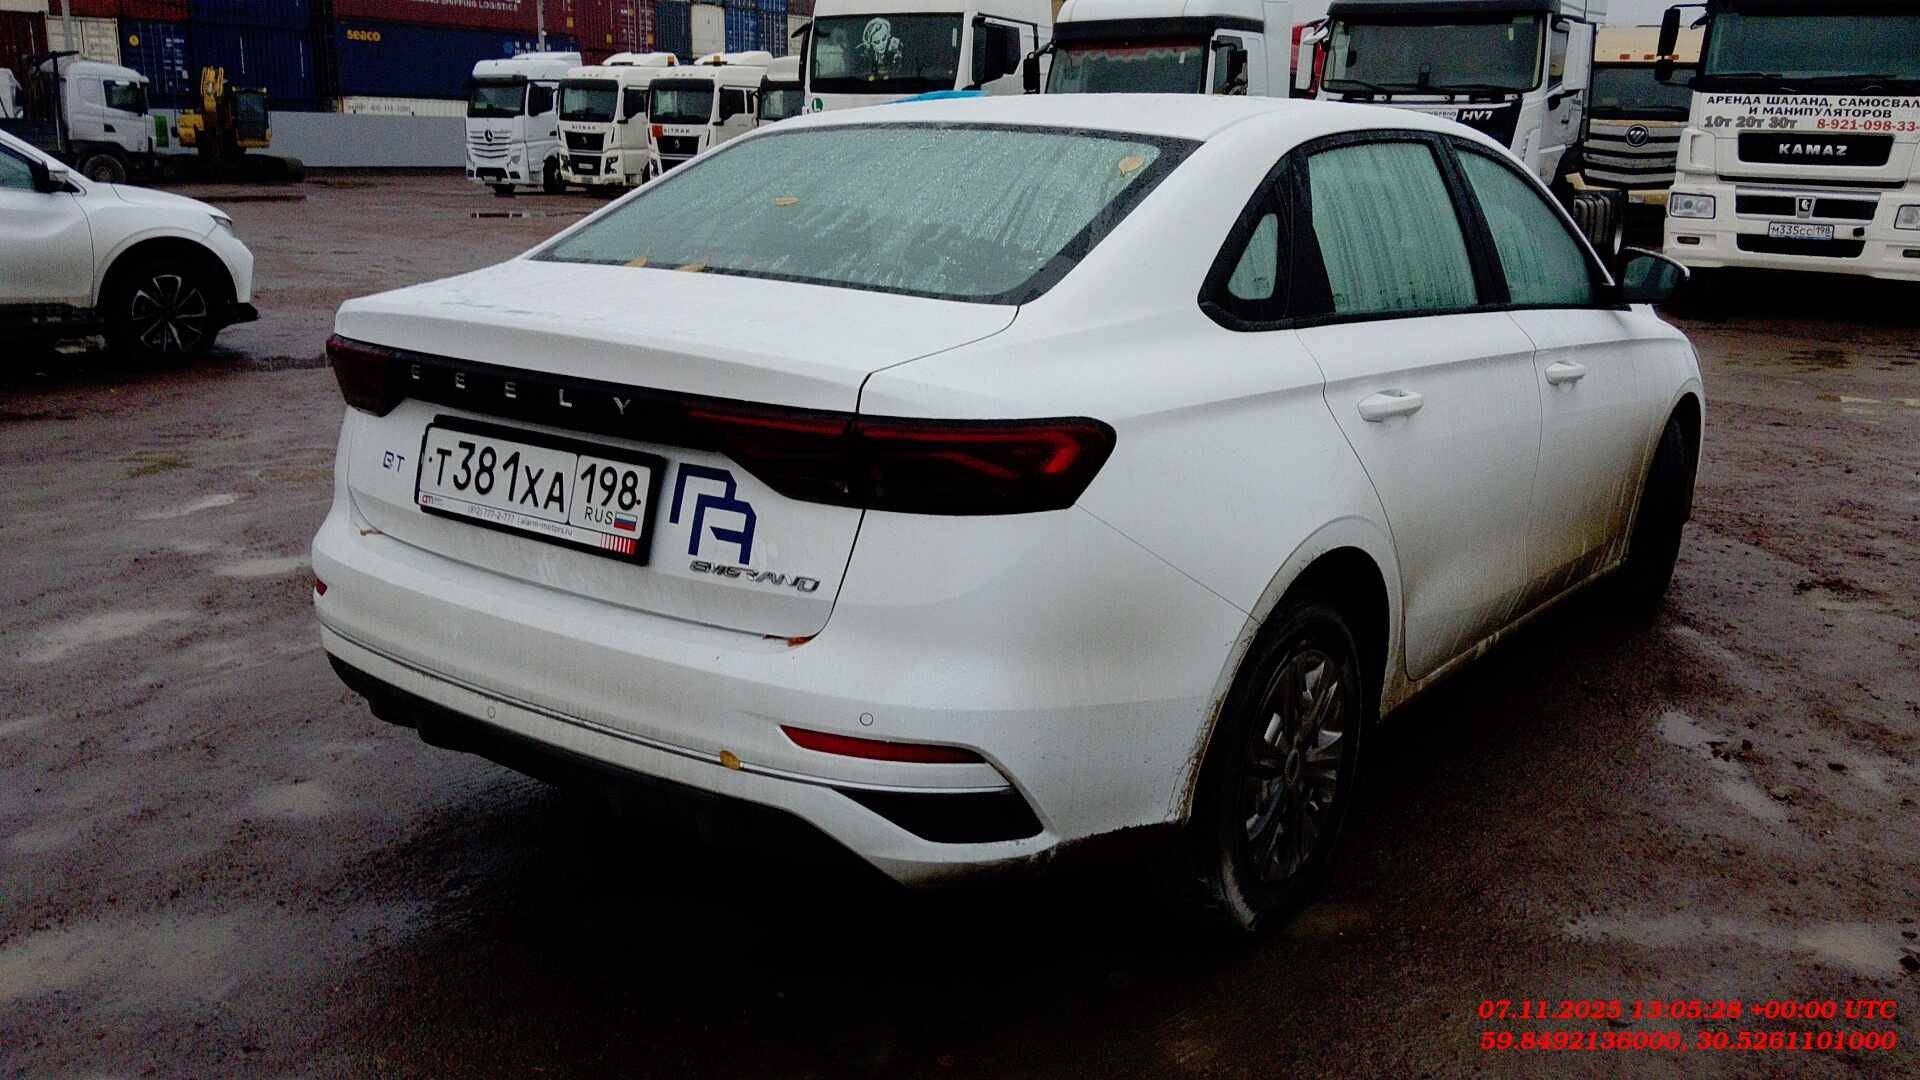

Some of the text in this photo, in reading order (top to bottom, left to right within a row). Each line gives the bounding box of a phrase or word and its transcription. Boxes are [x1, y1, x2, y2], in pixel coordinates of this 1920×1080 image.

[347, 29, 381, 42] seaco
[1706, 95, 1761, 105] АРЕНДА
[1766, 97, 1833, 108] ШАЛАНД,
[1461, 109, 1494, 121] HV7
[1748, 106, 1892, 118] И МАНИПУЛЯТОРОВ
[1778, 143, 1848, 156] KAMAZ
[410, 363, 631, 415] GEELY
[580, 462, 639, 512] 198
[583, 508, 614, 526] RUS
